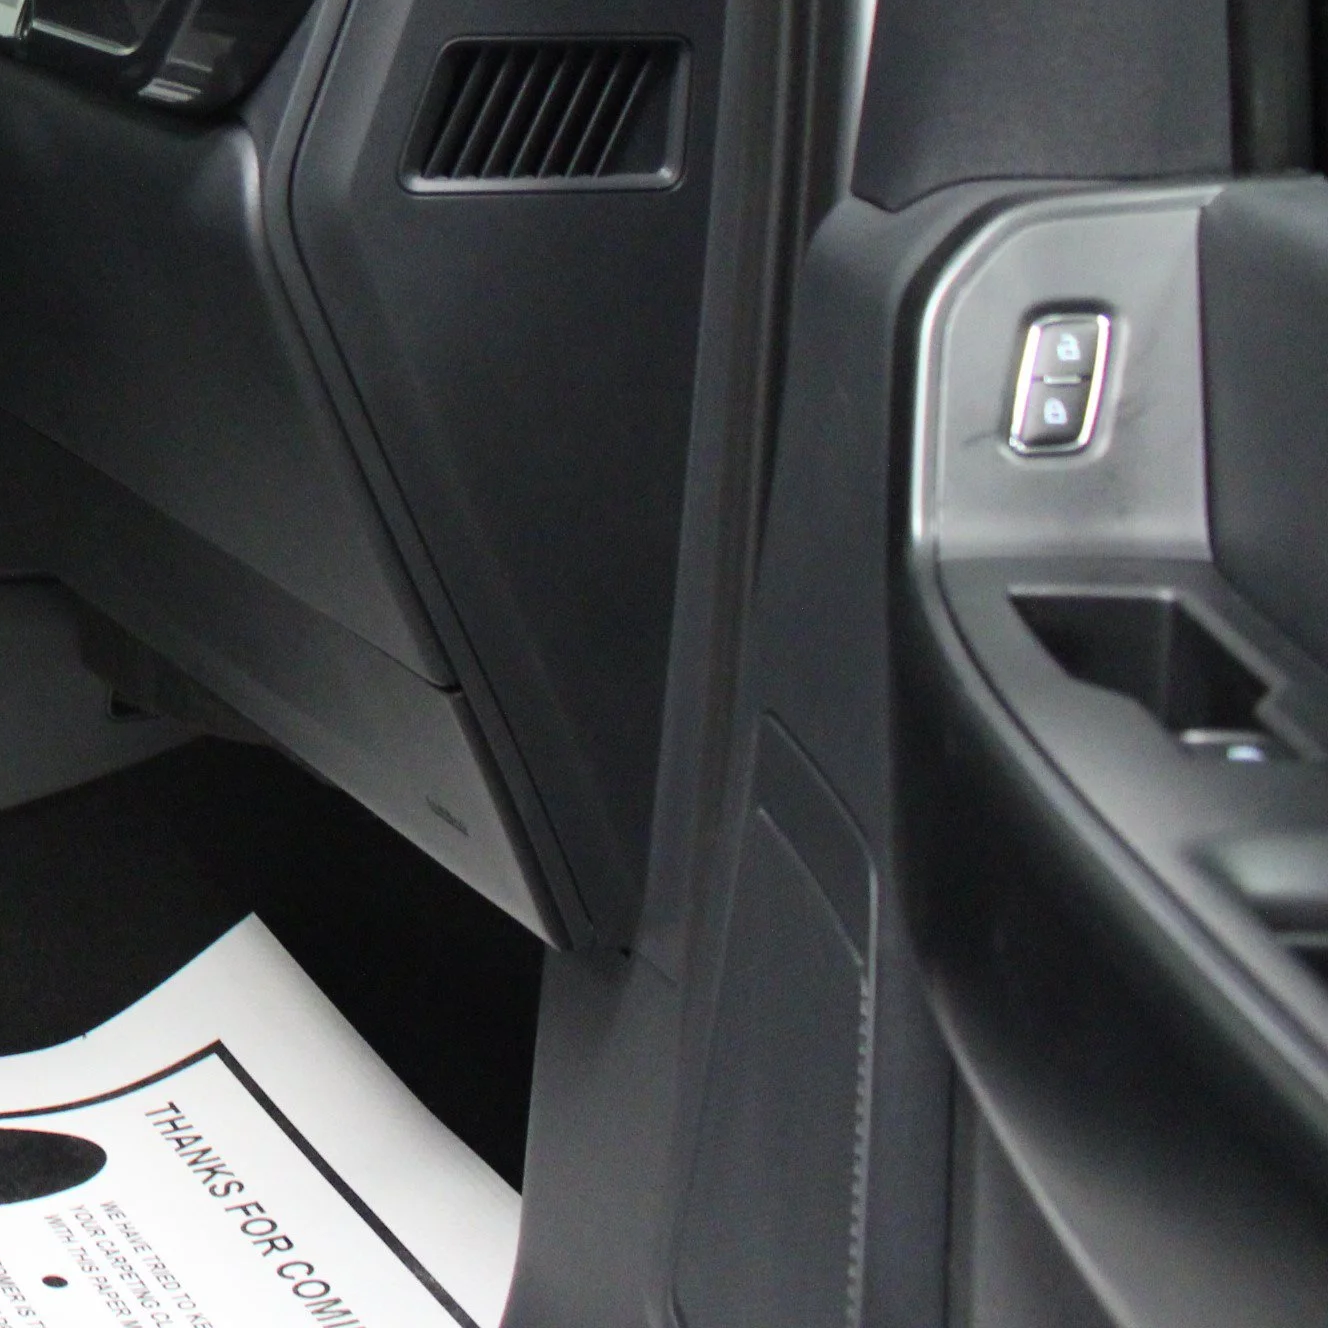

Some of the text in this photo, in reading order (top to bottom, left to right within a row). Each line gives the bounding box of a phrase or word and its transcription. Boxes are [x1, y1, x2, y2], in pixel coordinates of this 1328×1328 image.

[44, 1214, 78, 1243] WITH
[67, 1246, 99, 1273] THIS
[88, 1275, 132, 1317] PAPER
[69, 1204, 106, 1237] YOUR
[96, 1239, 160, 1309] CARPETING
[100, 1201, 127, 1220] WE
[116, 1221, 152, 1253] HAVE
[143, 1255, 181, 1290] TRIED
[171, 1292, 196, 1310] TO
[145, 1101, 365, 1328] THANKS FOR COMI
[14, 1305, 36, 1317] IS
